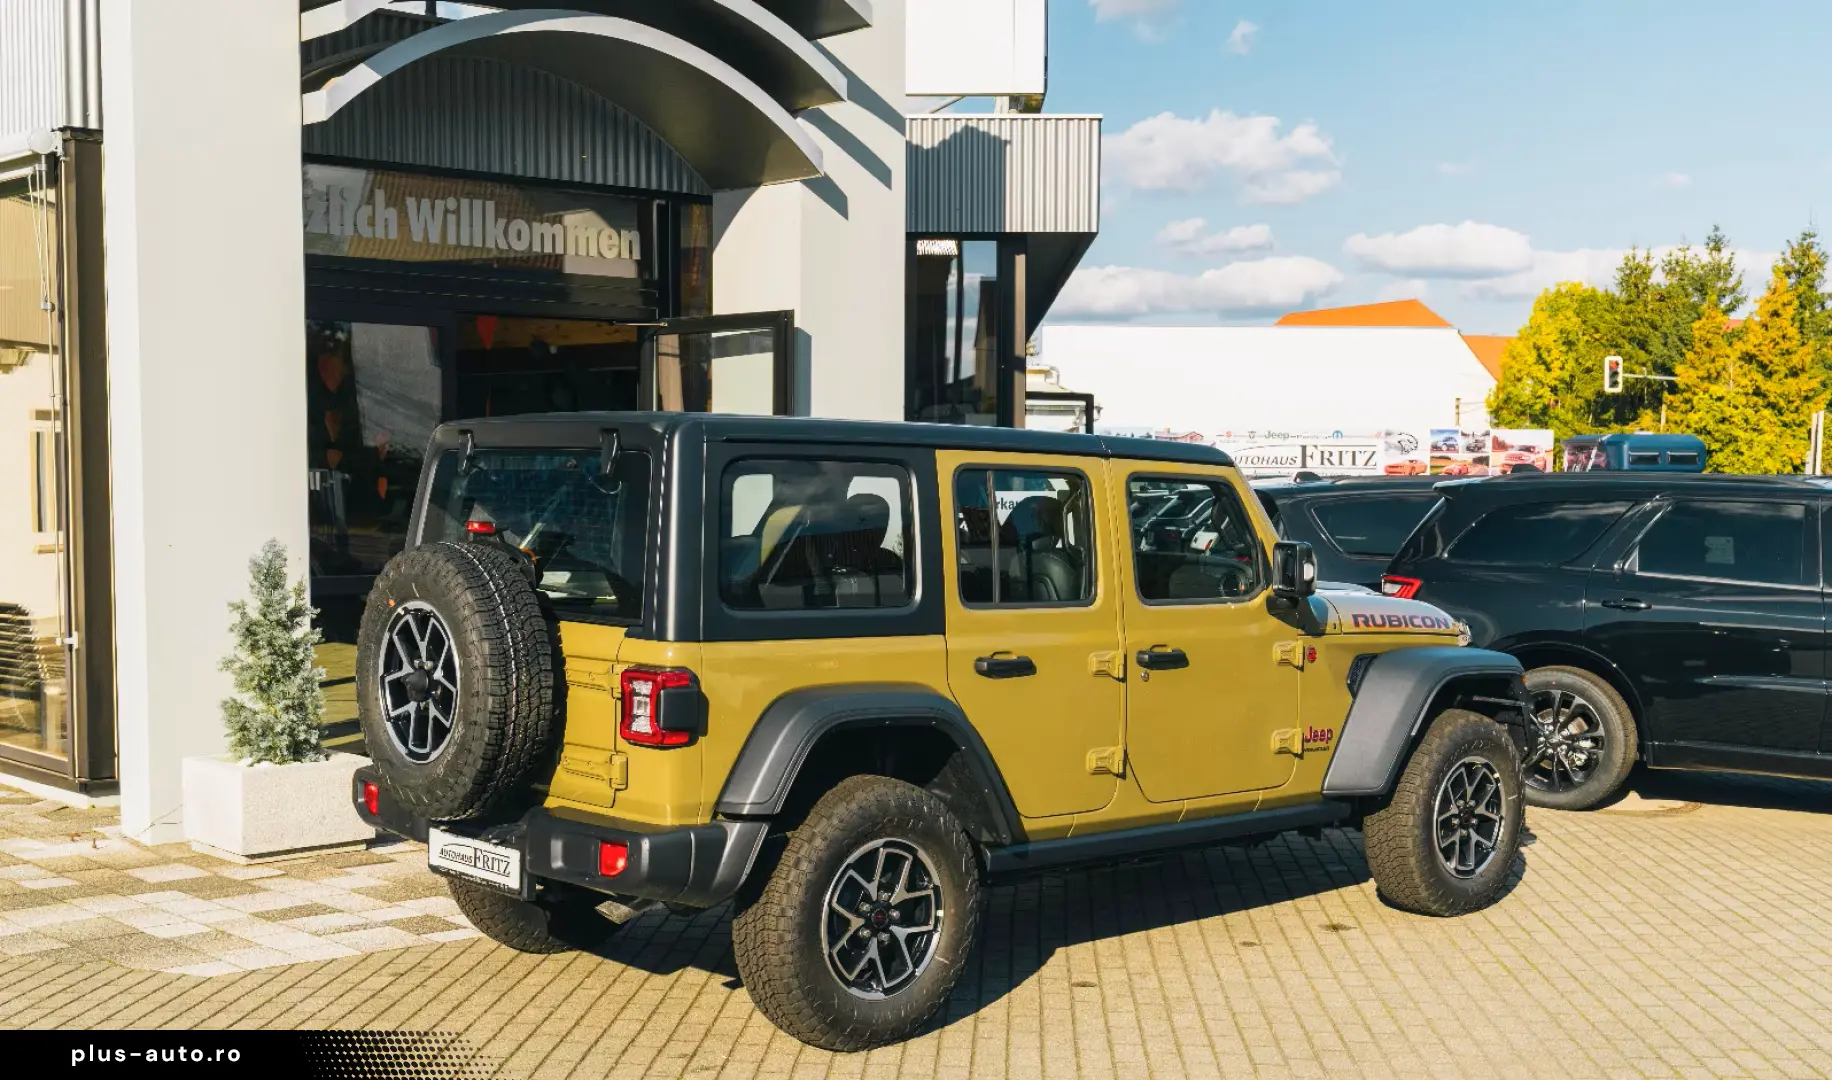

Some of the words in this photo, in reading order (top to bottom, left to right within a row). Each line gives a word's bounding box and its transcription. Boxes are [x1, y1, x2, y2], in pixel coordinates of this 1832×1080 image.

[405, 196, 641, 260] Willkommen
[1264, 430, 1290, 441] Jeep
[1300, 444, 1377, 468] FRITZ
[1351, 613, 1450, 629] RUBICON
[1304, 724, 1333, 745] Jeep
[439, 847, 473, 863] AUTOHAUS
[474, 847, 511, 875] FRITZ
